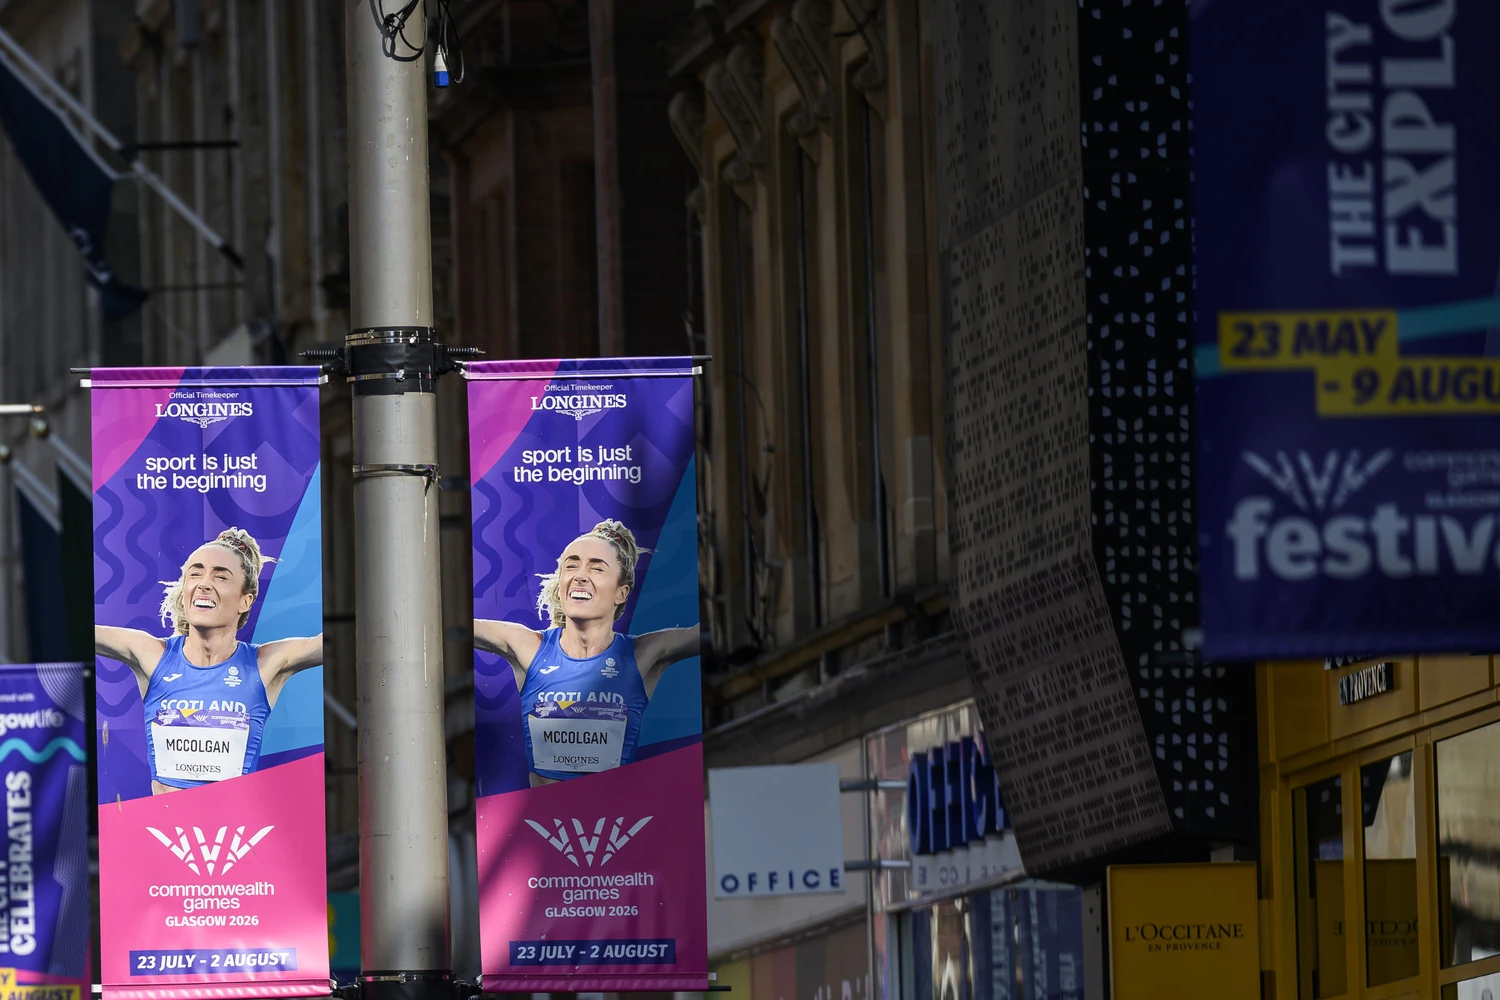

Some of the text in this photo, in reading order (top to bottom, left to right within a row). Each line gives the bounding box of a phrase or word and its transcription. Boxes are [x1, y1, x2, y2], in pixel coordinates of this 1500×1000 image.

[1324, 9, 1378, 276] THE CITY
[1229, 318, 1387, 359] 23 MAY
[543, 383, 613, 392] Official Timekeeper
[1352, 367, 1380, 405] 9
[168, 391, 239, 401] Official Timekeeper
[530, 393, 627, 411] LONGINES
[155, 402, 253, 418] LONGINES
[145, 452, 258, 474] sport is just
[522, 444, 633, 466] sport is just
[136, 472, 267, 493] the beginning
[513, 463, 642, 485] the beginning
[1224, 493, 1500, 582] festiv
[1349, 662, 1387, 704] PROVENCE
[166, 738, 230, 754] MCCOLGAN
[543, 730, 608, 745] MCCOLGAN
[175, 763, 221, 773] LONGINES
[553, 755, 600, 765] LONGINES
[5, 770, 37, 956] CELEBRATES
[148, 881, 275, 897] commonwealth
[527, 871, 655, 889] commonwealth
[720, 868, 841, 893] OFFICE
[183, 896, 241, 914] games
[562, 887, 620, 905] games
[165, 914, 259, 927] GLASGOW 2026
[545, 905, 639, 918] GLASGOW 2026
[1124, 921, 1245, 943] L'OCCITANE
[517, 945, 536, 960] 23
[539, 944, 576, 962] JULY
[590, 945, 600, 958] 2
[603, 942, 669, 959] AUGUST
[1147, 941, 1222, 953] EN PROVENCE
[137, 955, 156, 969] 23
[159, 954, 196, 970] JULY
[210, 955, 220, 967] 2
[223, 952, 290, 967] AUGUST
